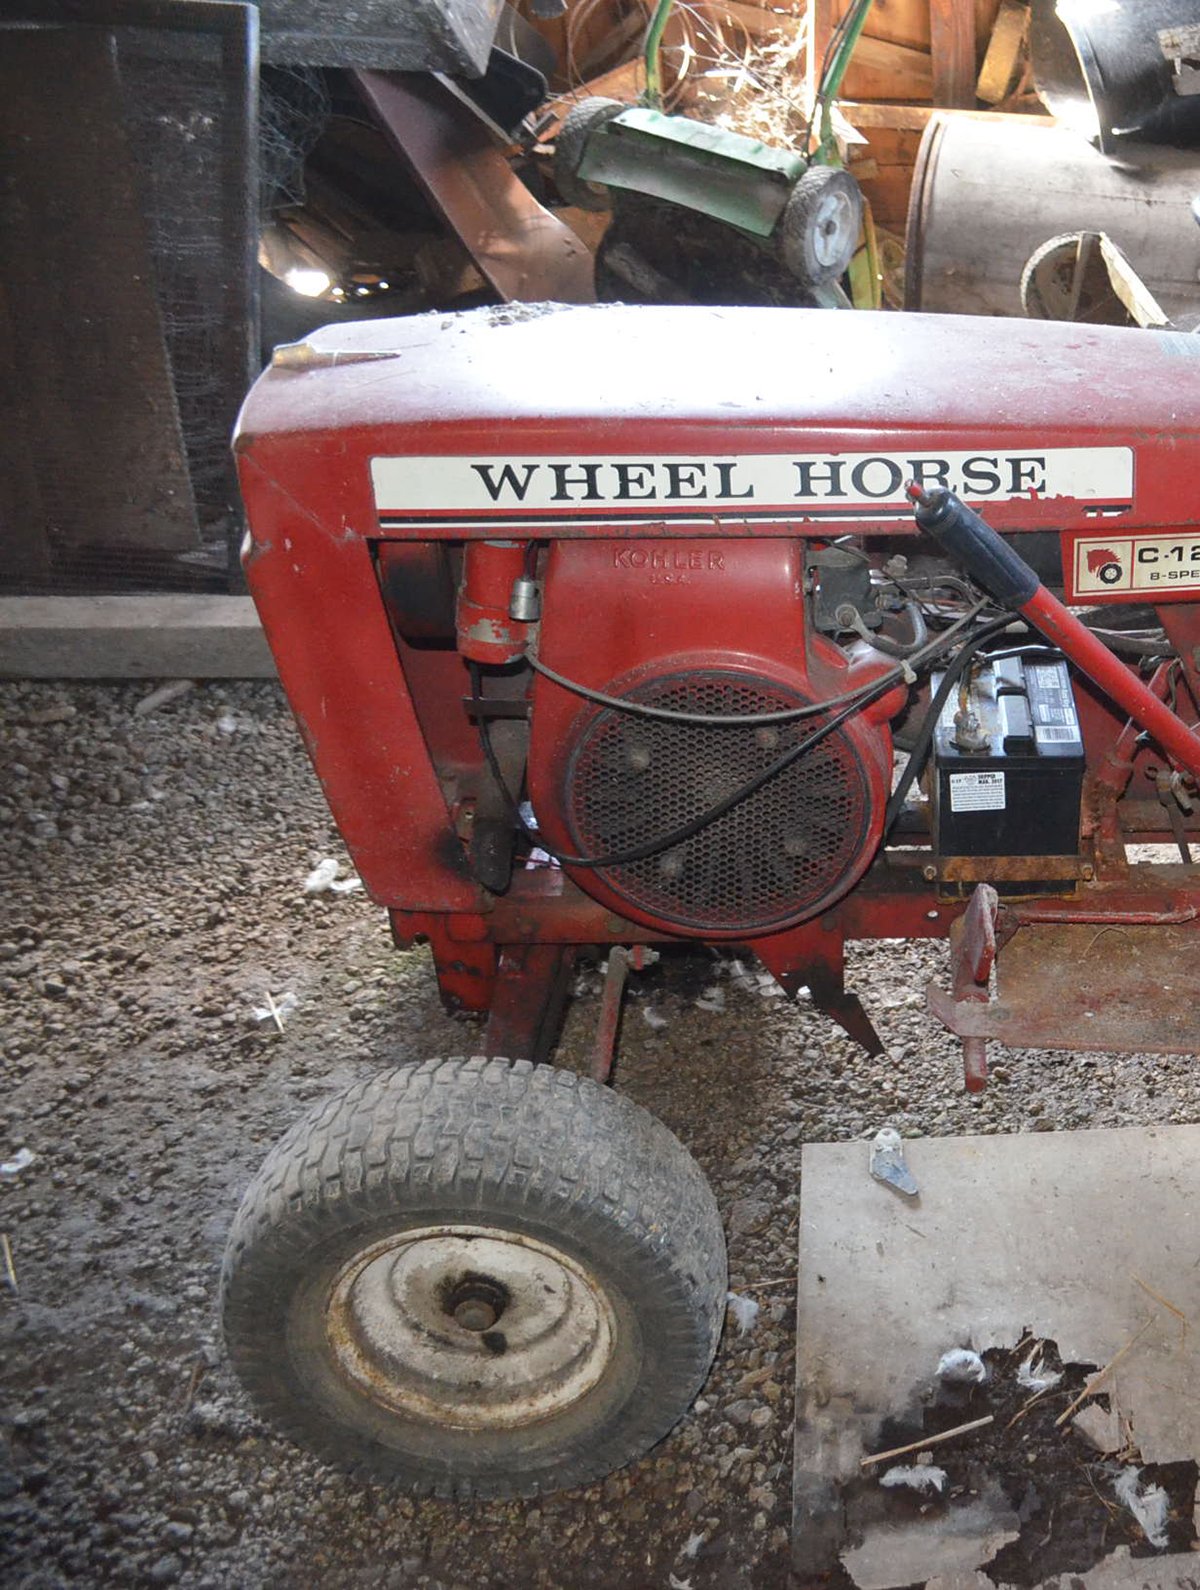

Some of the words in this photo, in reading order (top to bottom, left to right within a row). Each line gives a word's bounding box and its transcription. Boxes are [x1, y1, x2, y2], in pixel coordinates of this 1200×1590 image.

[470, 463, 755, 501] WHEEL
[792, 456, 1047, 499] HORSE
[613, 549, 726, 571] KOHLER
